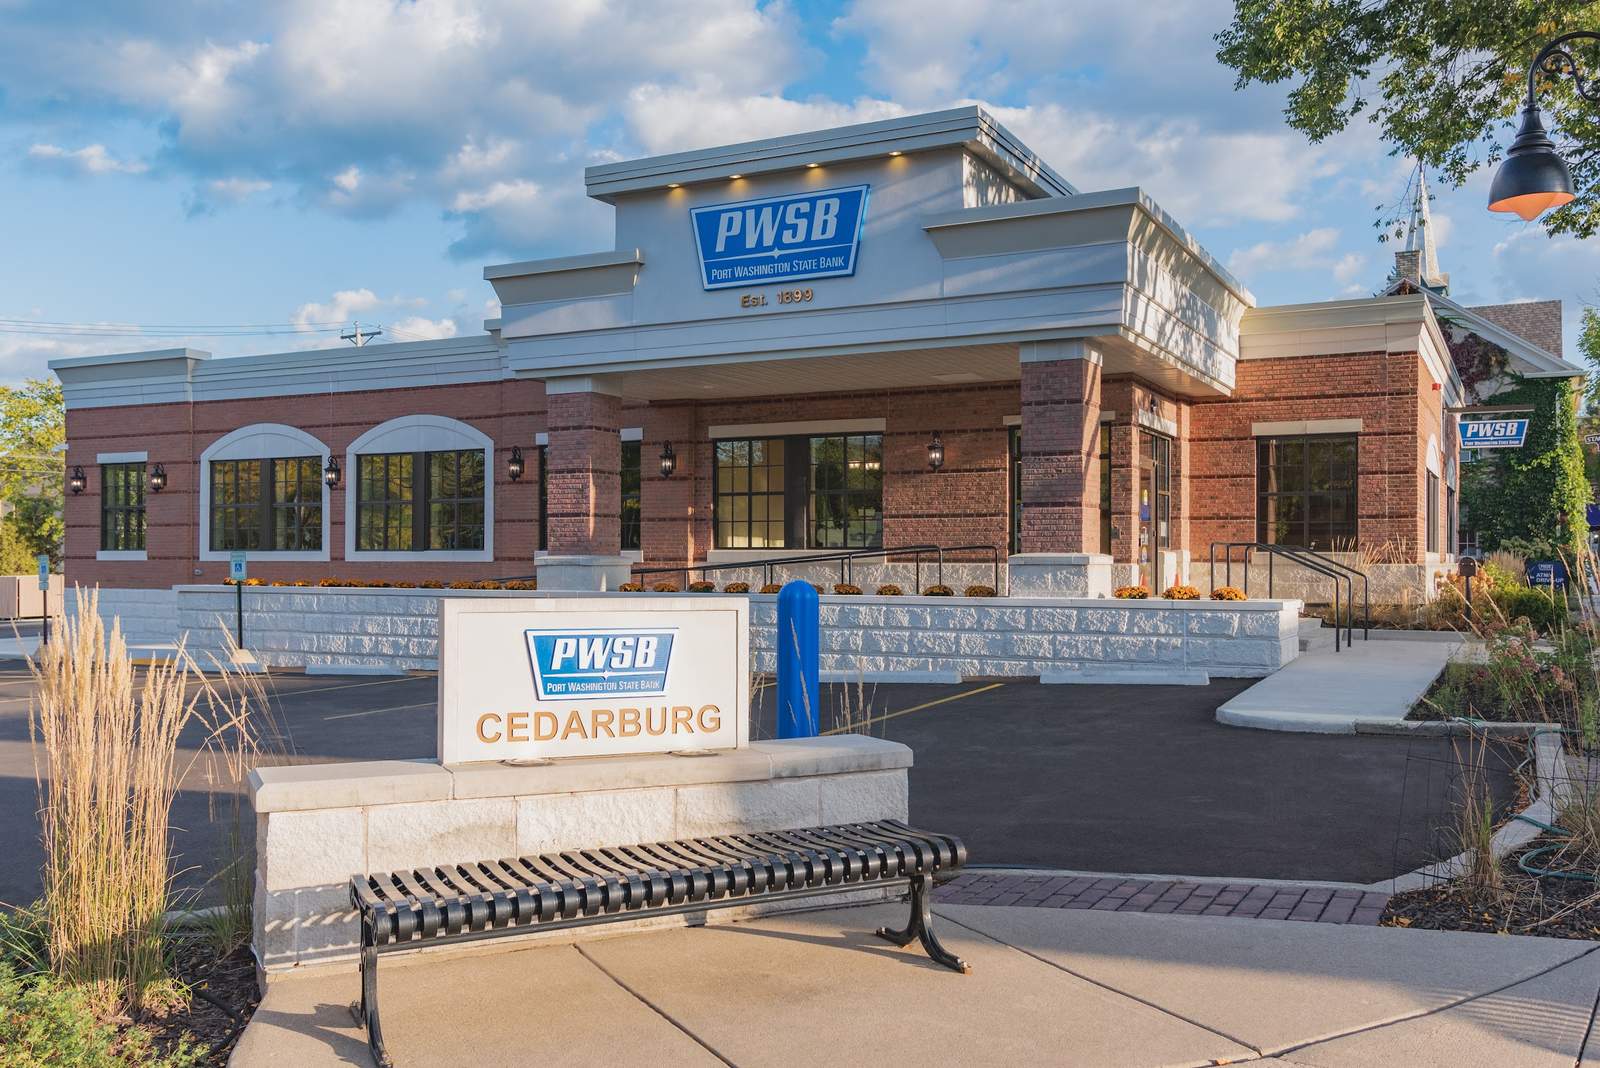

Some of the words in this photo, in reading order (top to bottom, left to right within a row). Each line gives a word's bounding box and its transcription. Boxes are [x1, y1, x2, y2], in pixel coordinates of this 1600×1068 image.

[715, 197, 840, 252] PWSB
[711, 268, 733, 281] PORT
[734, 262, 791, 278] WASHINGTON
[793, 259, 818, 272] STATE
[819, 256, 845, 269] BANK
[777, 287, 814, 305] 1899
[1466, 422, 1518, 437] PWSB
[550, 636, 660, 671] PWSB
[546, 682, 566, 693] PORT
[567, 681, 617, 692] WASHINGTON
[618, 680, 639, 690] STATE
[640, 679, 661, 690] BANK
[476, 704, 721, 744] CEDARBURG
